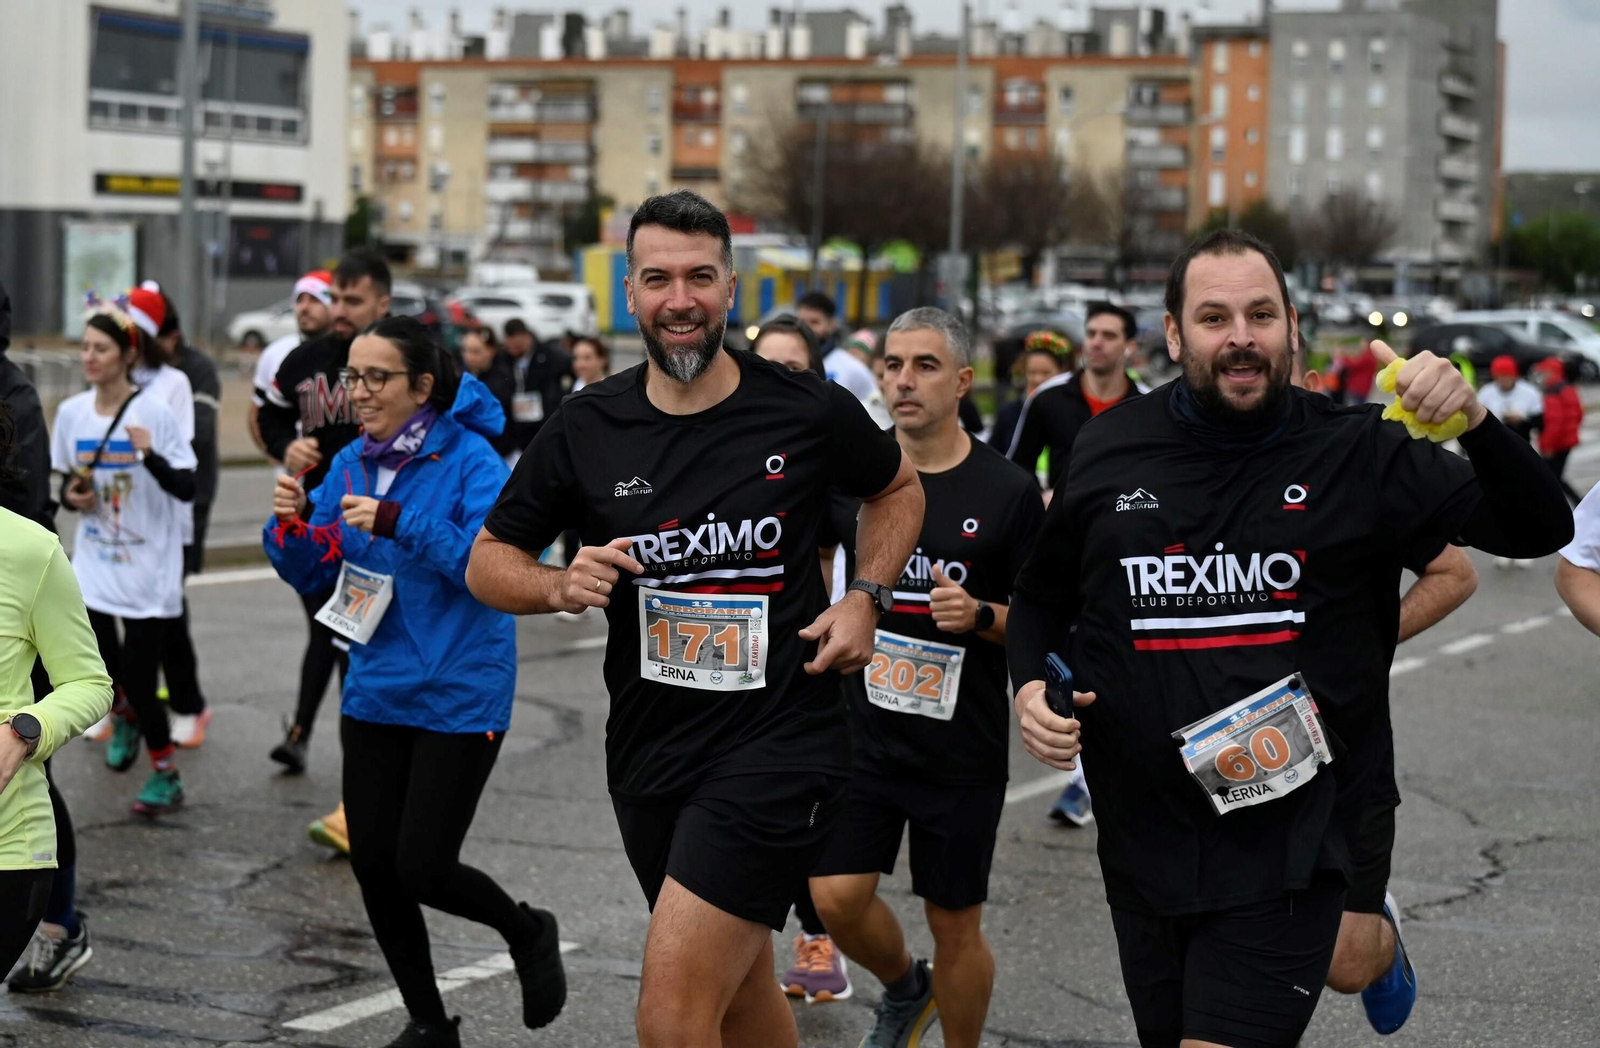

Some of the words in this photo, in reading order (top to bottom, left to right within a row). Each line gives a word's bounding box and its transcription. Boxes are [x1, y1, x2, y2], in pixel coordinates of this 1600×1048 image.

[643, 563, 666, 571] LUB
[1131, 597, 1168, 608] CLUB
[1176, 593, 1268, 606] DEPORTIVO
[648, 618, 740, 667] 171
[868, 653, 943, 700] 202
[1229, 707, 1251, 724] 12
[1215, 726, 1290, 781] 60
